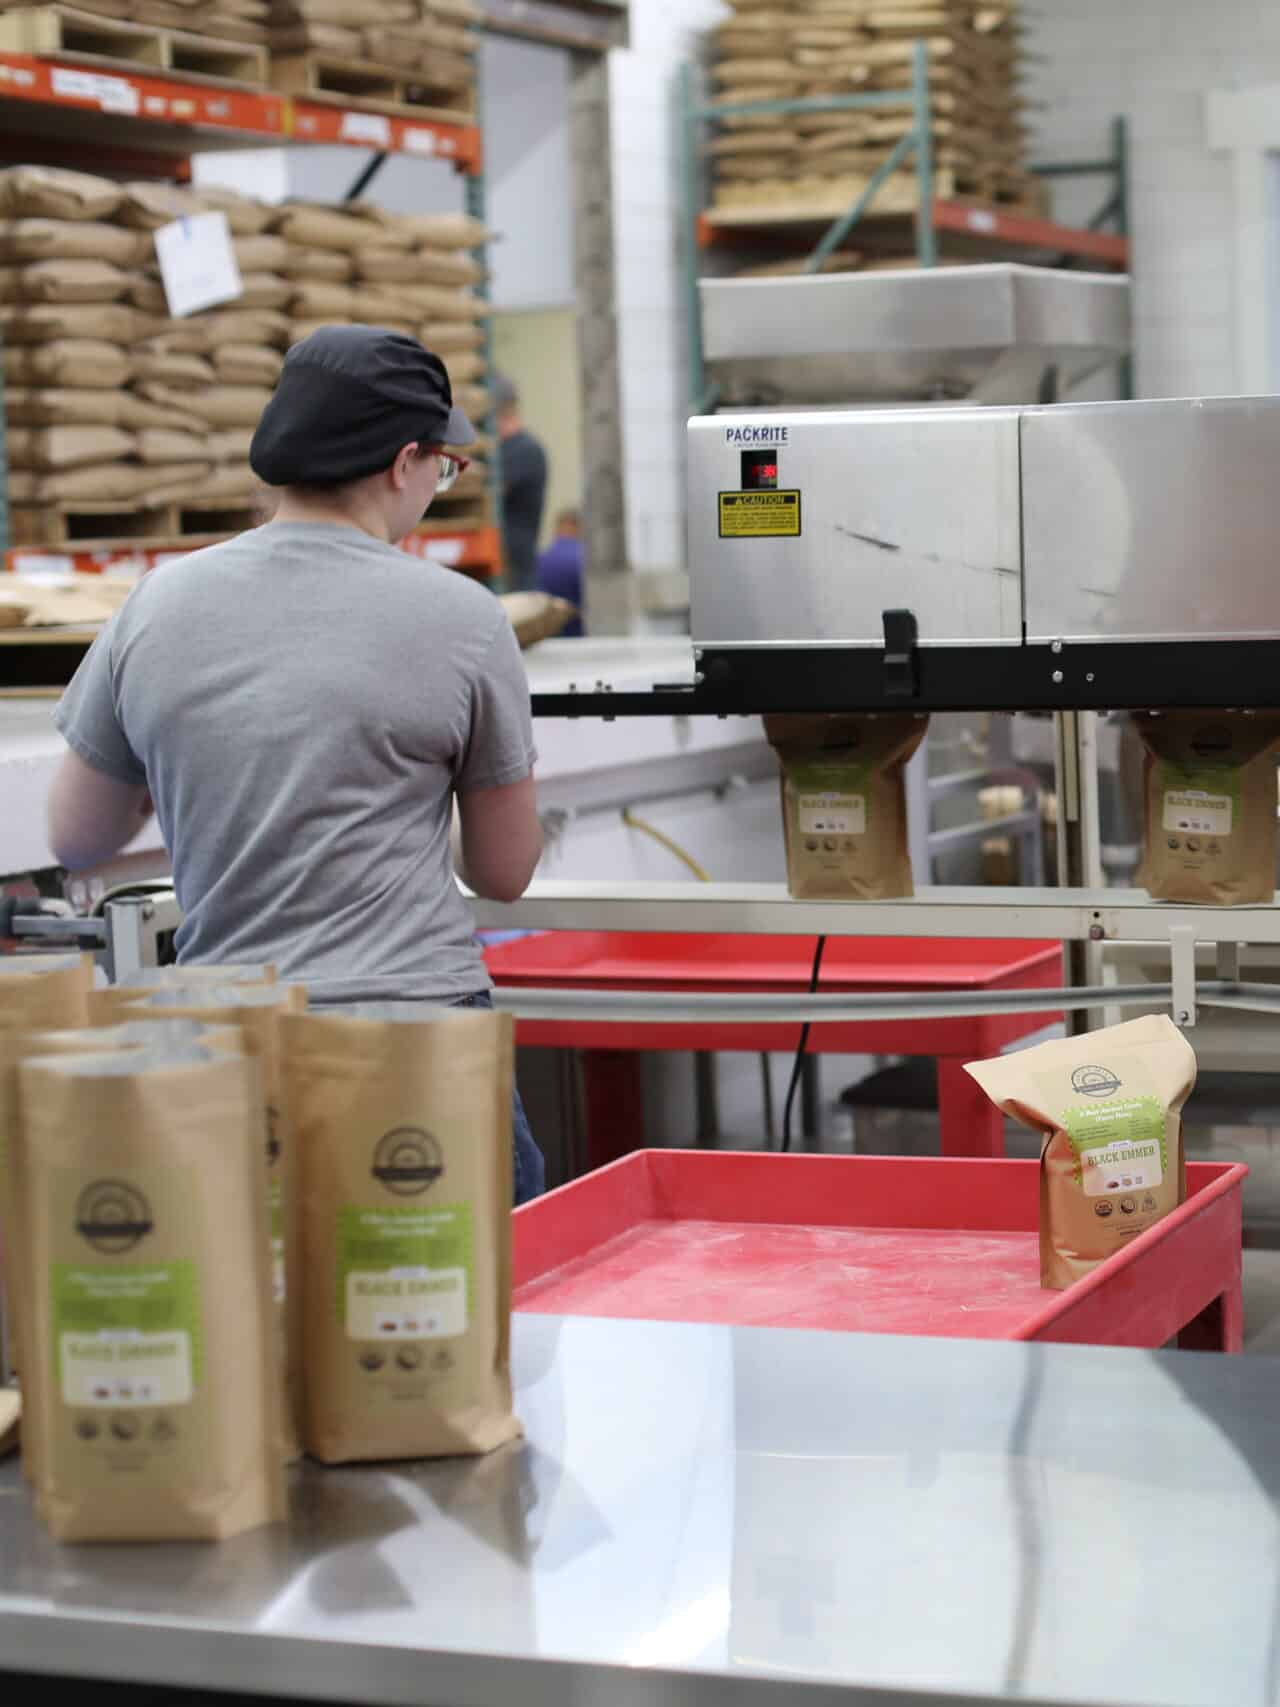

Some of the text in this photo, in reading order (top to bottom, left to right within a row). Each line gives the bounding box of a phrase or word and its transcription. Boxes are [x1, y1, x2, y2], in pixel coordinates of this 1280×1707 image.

[726, 426, 788, 441] PACKRITE
[743, 495, 785, 505] CAUTION
[1086, 1146, 1155, 1168] BLACK EMMER
